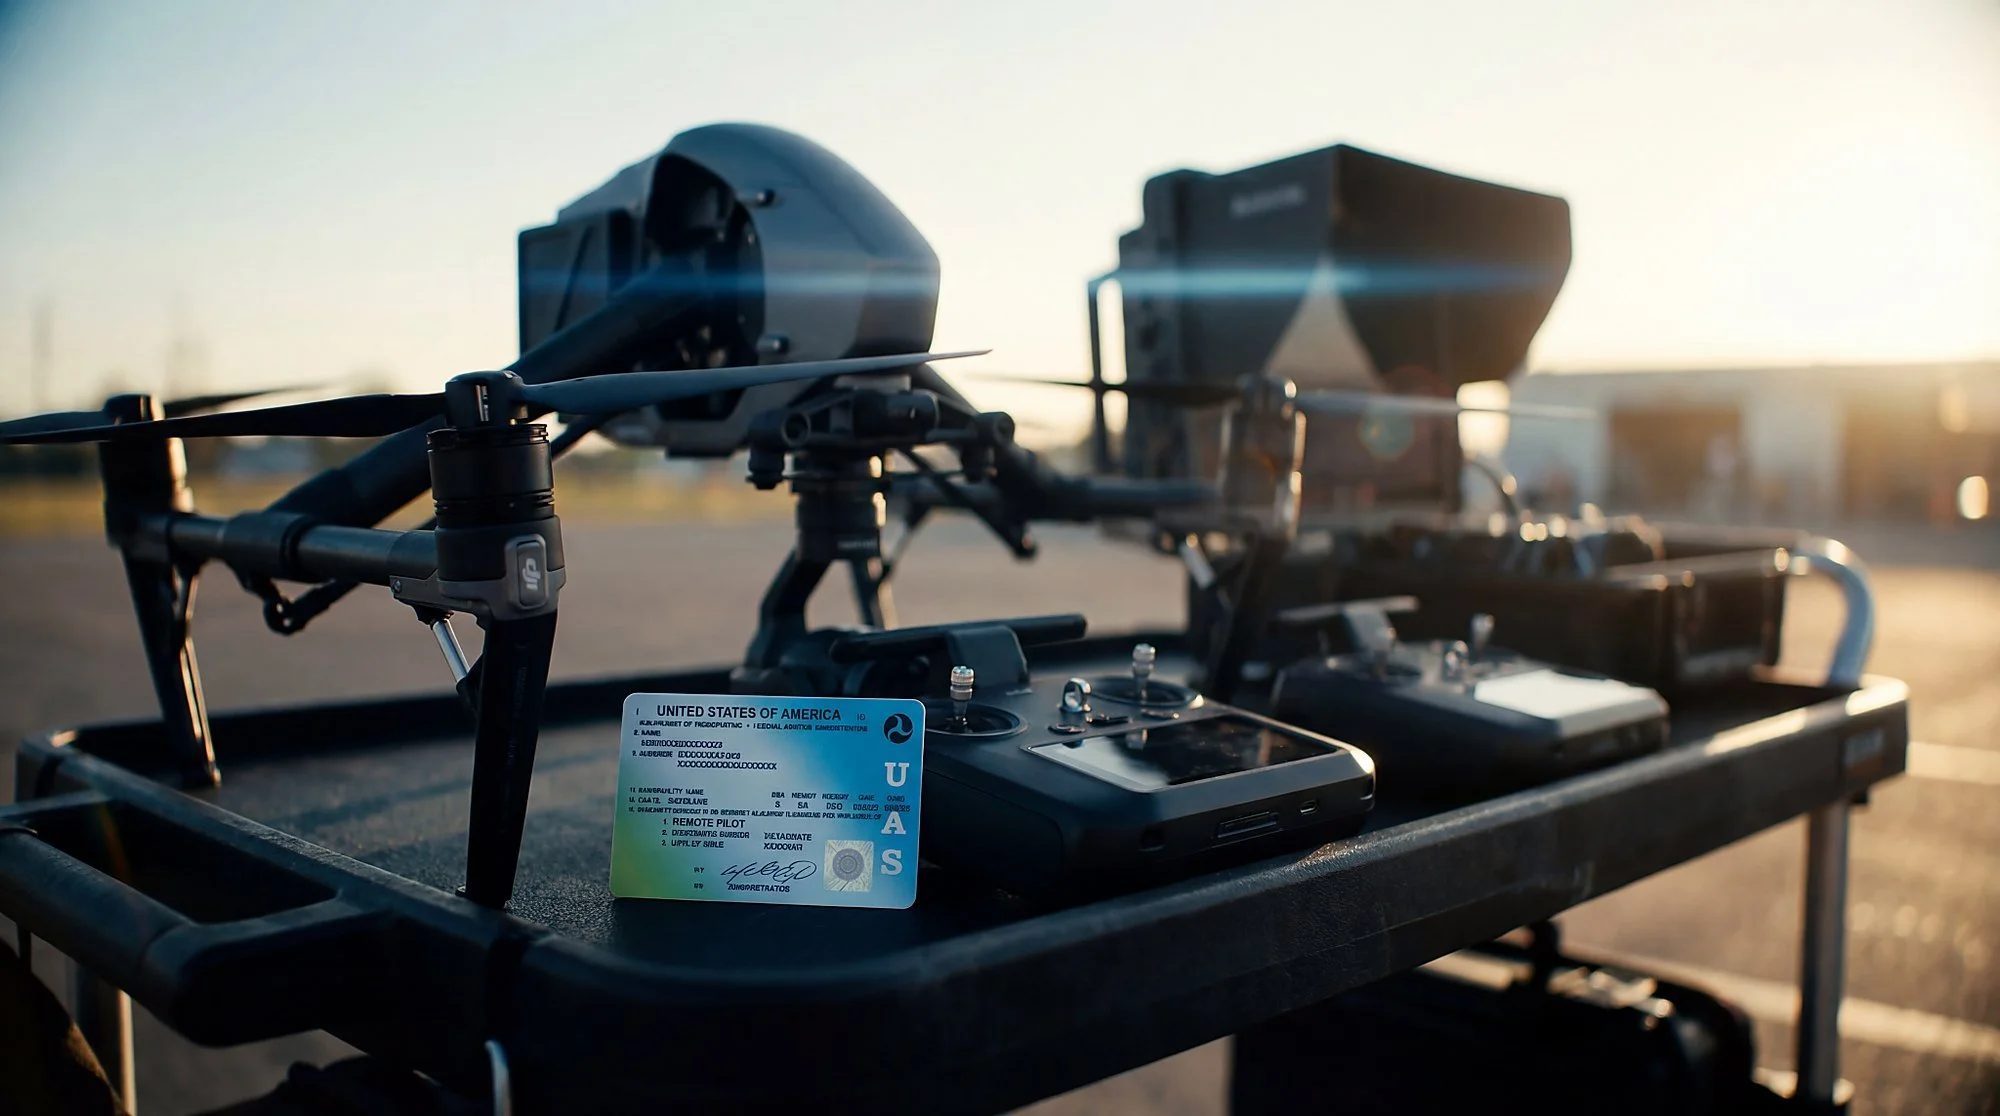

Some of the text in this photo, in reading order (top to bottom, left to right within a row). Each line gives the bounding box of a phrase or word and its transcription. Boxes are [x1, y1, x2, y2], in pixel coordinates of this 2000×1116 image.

[657, 705, 842, 721] UNITED STATES OF AMERICA
[673, 818, 714, 828] REMOTE
[716, 819, 746, 829] PILOT
